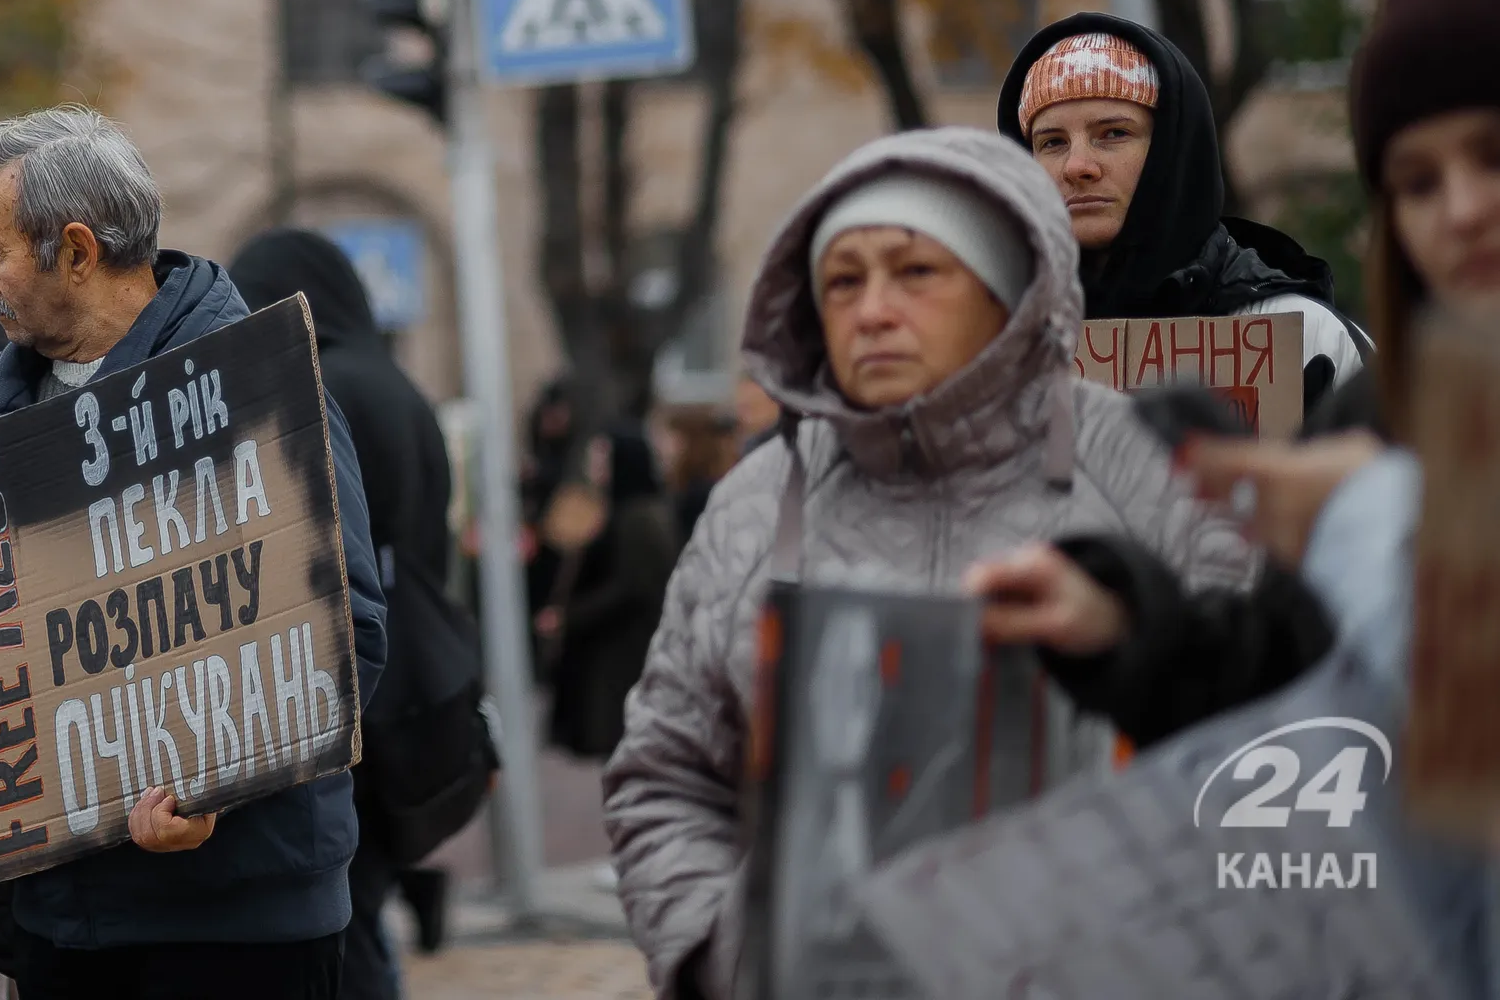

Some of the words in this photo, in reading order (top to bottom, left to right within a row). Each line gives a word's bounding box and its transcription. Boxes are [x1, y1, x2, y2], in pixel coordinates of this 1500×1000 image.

[1073, 317, 1275, 390] ЧАННЯ
[88, 439, 273, 578] ПЕКЛА
[45, 539, 264, 687] РОЗПАЧУ
[54, 621, 340, 837] ОЧІКУВАНЬ
